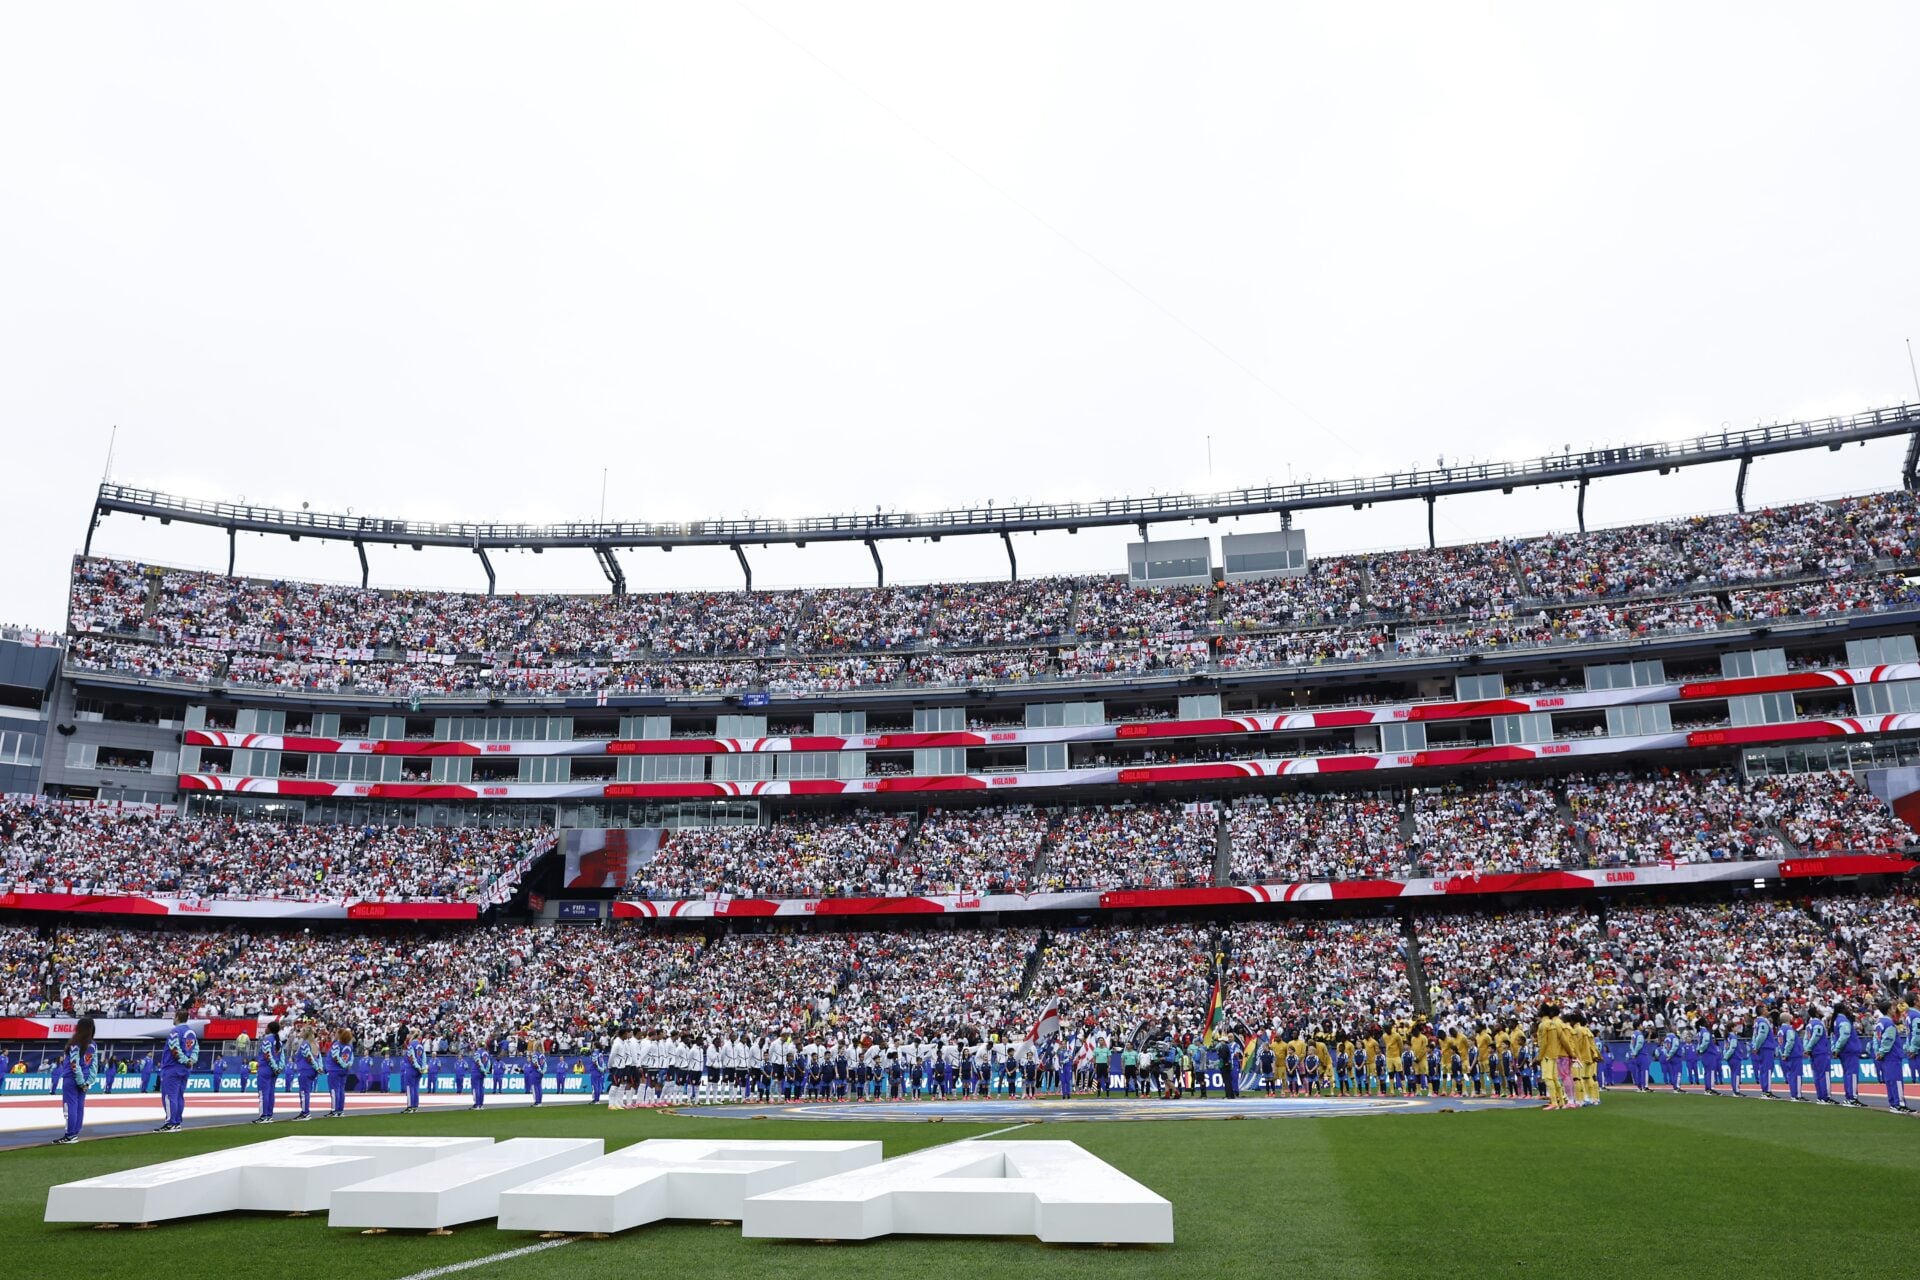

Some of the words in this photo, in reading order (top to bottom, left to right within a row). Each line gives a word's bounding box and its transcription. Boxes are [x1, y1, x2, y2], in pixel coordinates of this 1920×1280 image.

[5, 1077, 23, 1090] THE
[23, 1077, 43, 1090] FIFA
[186, 1078, 211, 1089] FIFA
[44, 1135, 1174, 1244] FIFA
